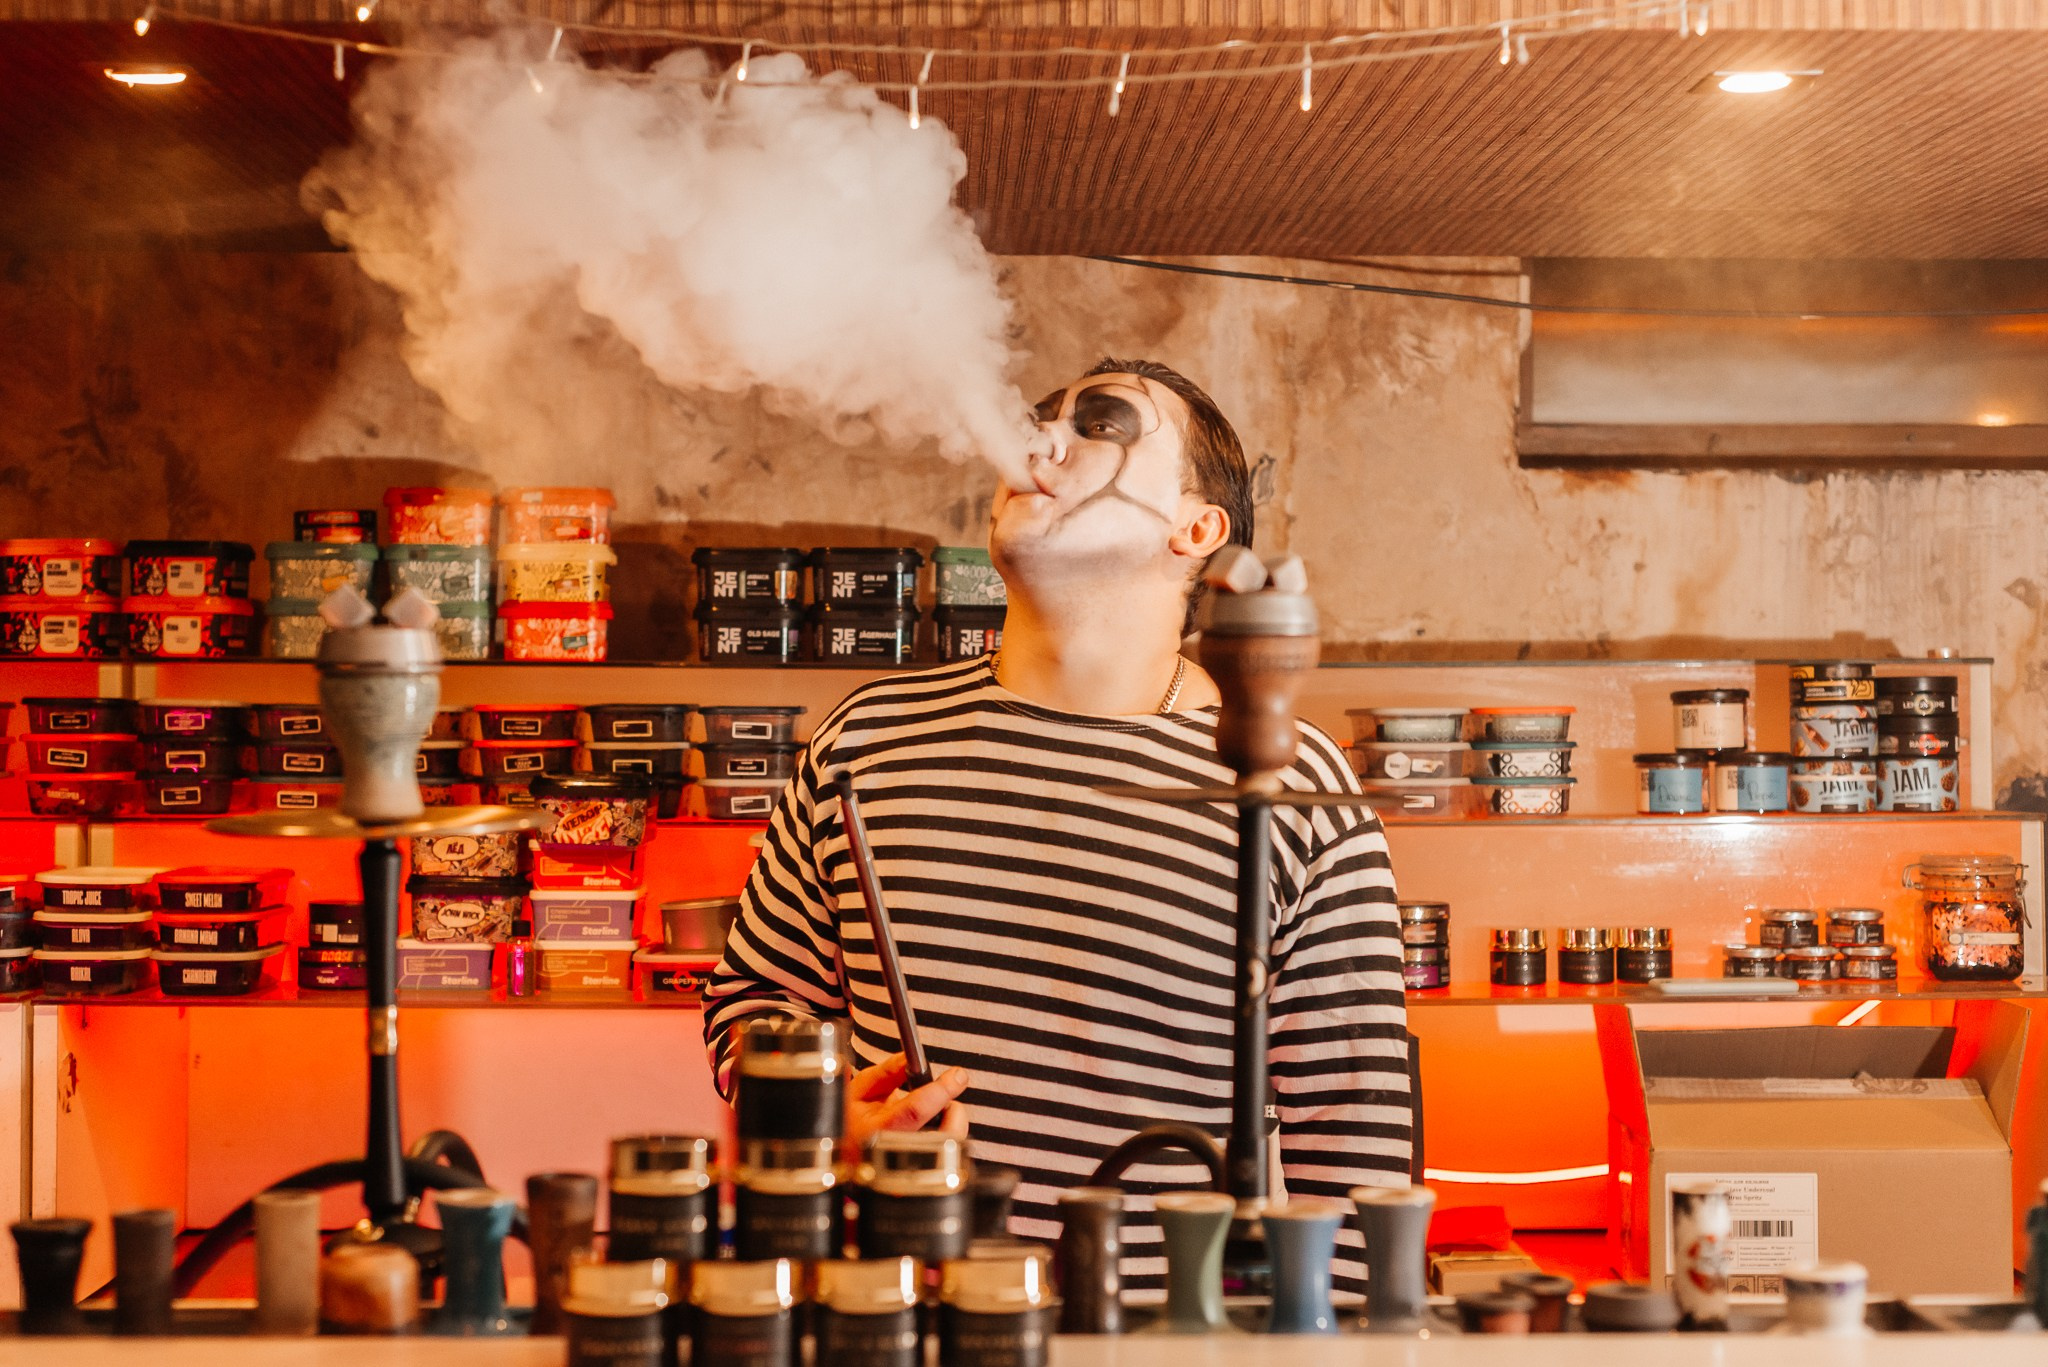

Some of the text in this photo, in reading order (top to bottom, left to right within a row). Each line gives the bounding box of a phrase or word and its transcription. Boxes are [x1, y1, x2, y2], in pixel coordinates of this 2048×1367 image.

[747, 630, 780, 638] OLD SAGE
[1893, 767, 1931, 793] JAM
[1820, 780, 1859, 795] JAM
[583, 876, 621, 886] Starline
[62, 890, 101, 906] TROPIC JUICE
[185, 892, 223, 908] SWEET MELON
[582, 926, 620, 936] Starline
[182, 969, 217, 985] CRANBERRY
[441, 976, 479, 986] Starline
[582, 976, 621, 986] Starline
[662, 977, 708, 985] GRAPEFRUIT
